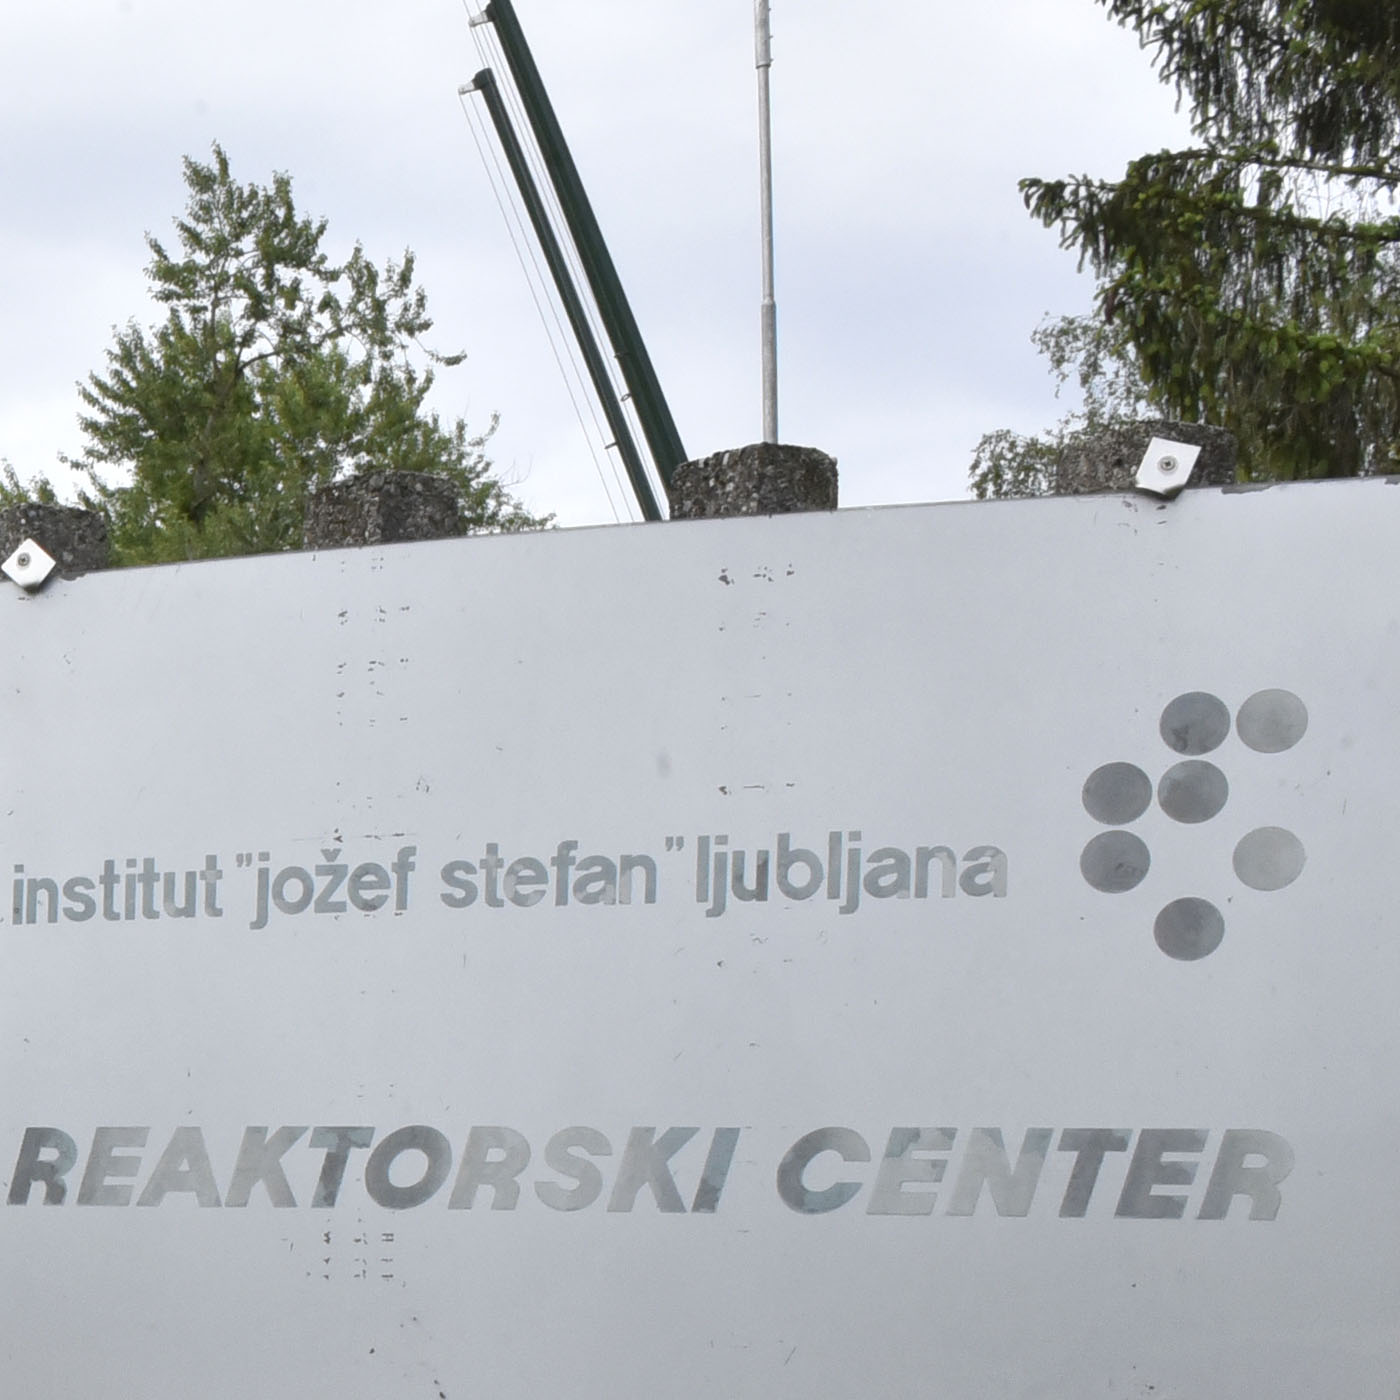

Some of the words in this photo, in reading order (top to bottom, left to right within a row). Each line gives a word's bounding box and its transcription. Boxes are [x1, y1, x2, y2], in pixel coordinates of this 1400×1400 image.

[12, 854, 224, 925] institut
[695, 830, 1008, 918] ljubljana
[7, 1124, 742, 1214] REAKTORSKI
[777, 1125, 1296, 1222] CENTER
